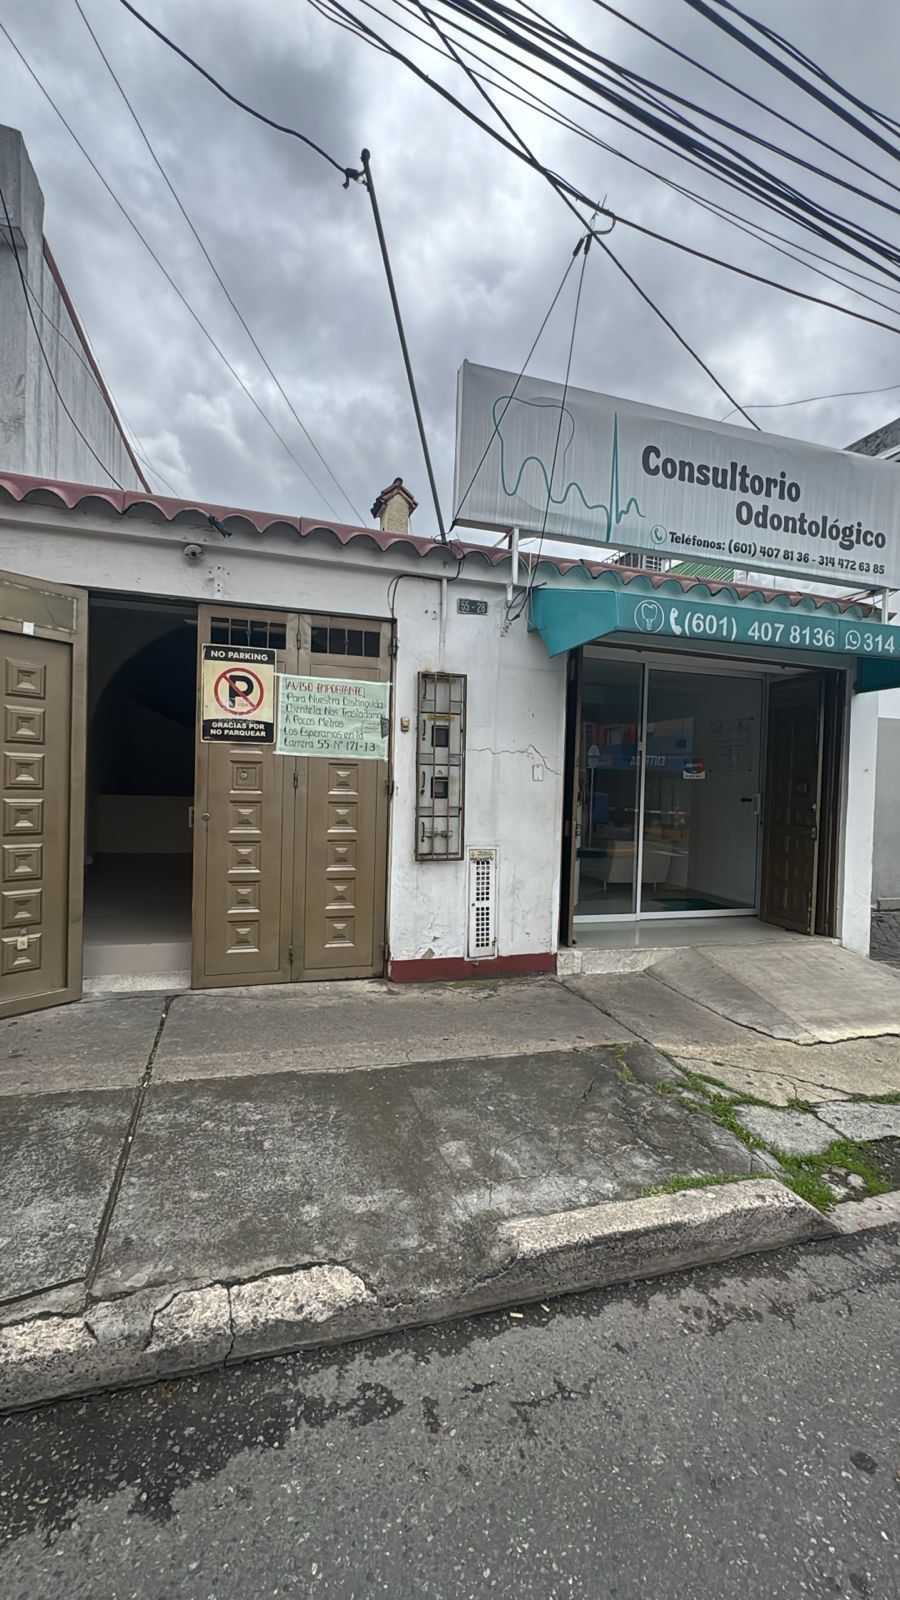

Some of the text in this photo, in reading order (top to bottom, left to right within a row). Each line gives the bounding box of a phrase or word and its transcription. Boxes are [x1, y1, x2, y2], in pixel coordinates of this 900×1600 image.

[642, 446, 801, 502] Consultorio
[736, 501, 886, 550] Odontológico
[669, 532, 726, 550] Teléfonos:
[728, 539, 757, 557] (601)
[759, 546, 781, 559] 407
[783, 550, 794, 561] 81
[796, 552, 810, 563] 36
[818, 556, 835, 567] 314
[838, 558, 857, 571] 472
[858, 562, 871, 573] 63
[873, 564, 885, 575] 85
[684, 611, 896, 654] (601) 407 8136 314
[210, 650, 269, 661] NO PARKING
[228, 674, 254, 708] P
[286, 692, 306, 703] Para
[308, 693, 340, 705] Nuestra
[285, 703, 322, 715] Clientela
[211, 721, 247, 730] GRACIAS
[293, 714, 315, 726] Pocos
[318, 717, 344, 728] Metros
[224, 729, 266, 737] PARQUEAR
[284, 726, 298, 736] Los
[300, 727, 343, 740] Esperamos
[317, 740, 330, 750] 55
